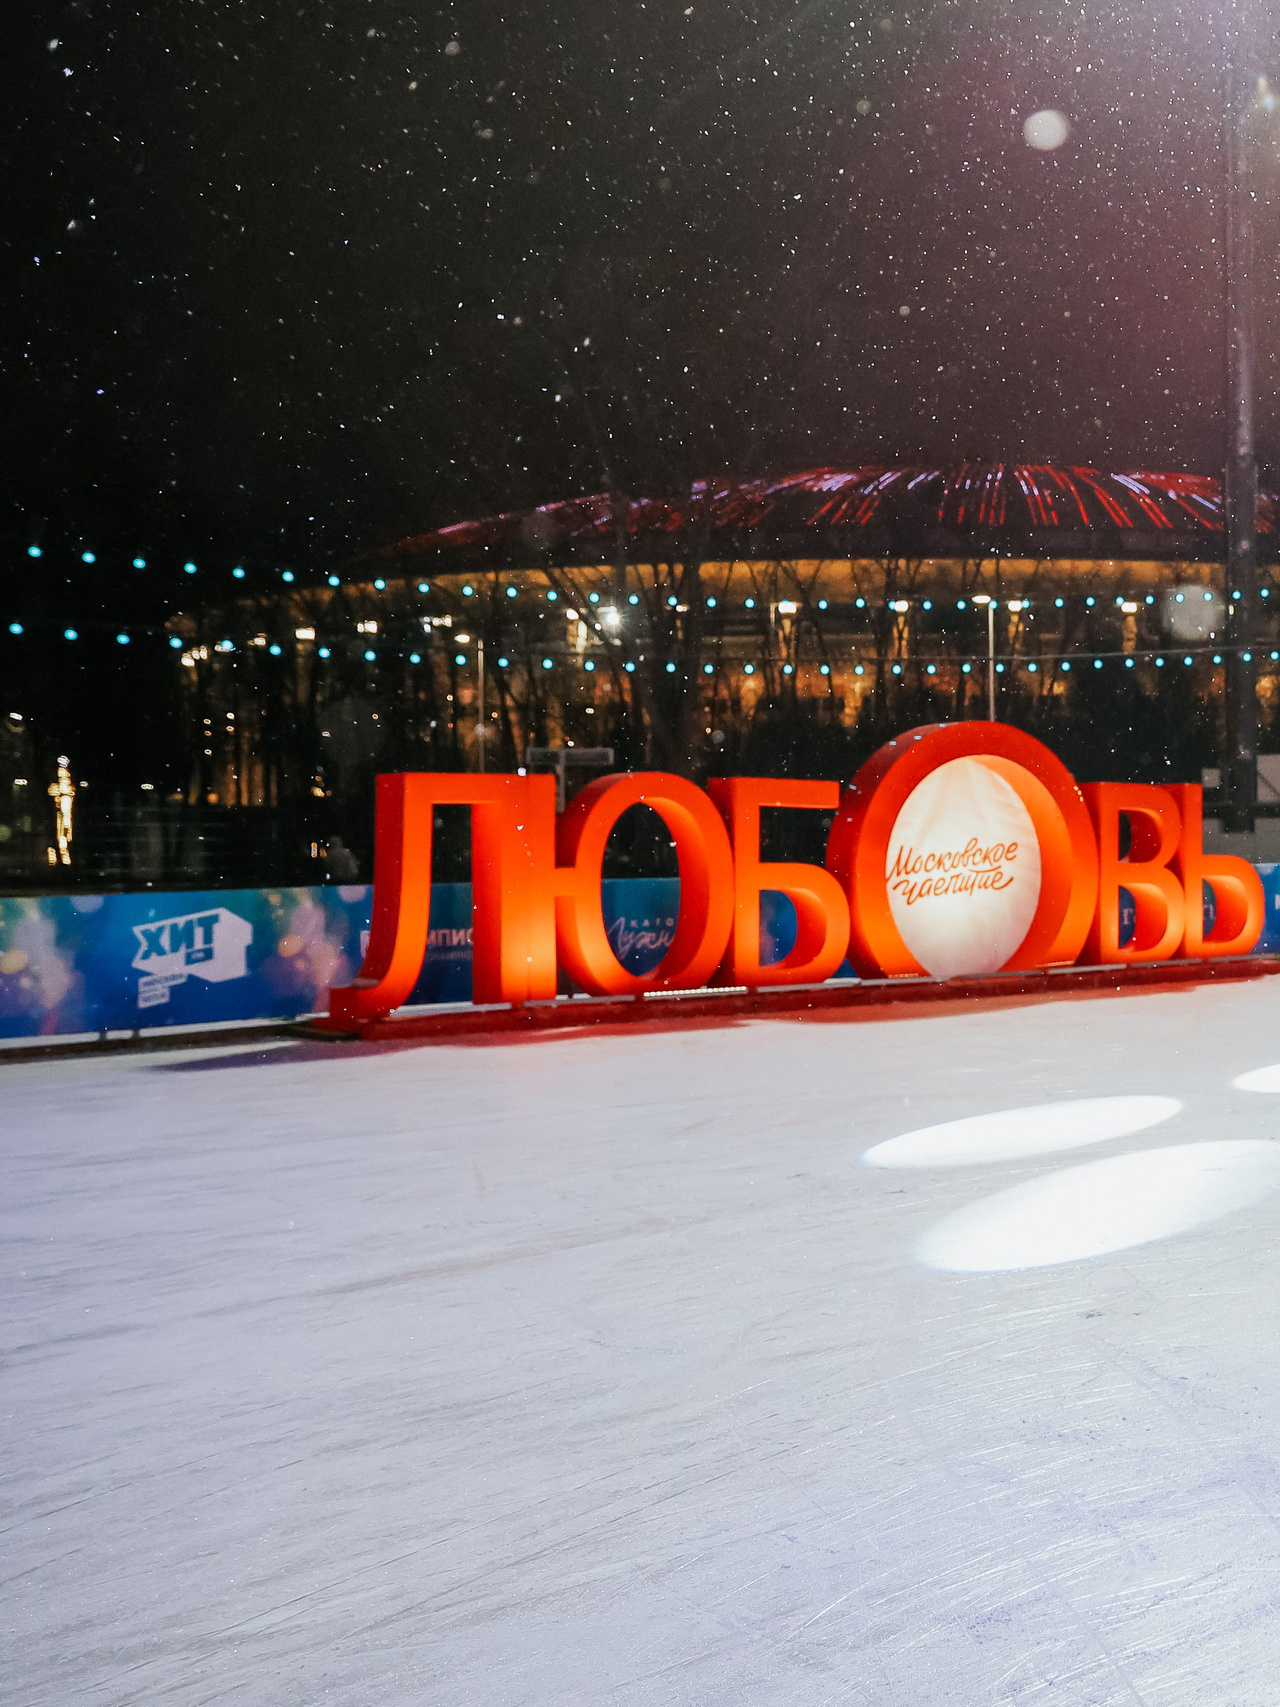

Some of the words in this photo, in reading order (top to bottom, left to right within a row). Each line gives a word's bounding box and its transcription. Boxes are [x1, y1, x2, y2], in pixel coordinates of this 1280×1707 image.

[329, 720, 1266, 1020] ЛЮБОВЬ
[886, 837, 1018, 883] Московское
[893, 865, 1014, 905] чаепитие
[140, 914, 220, 961] ХИТ
